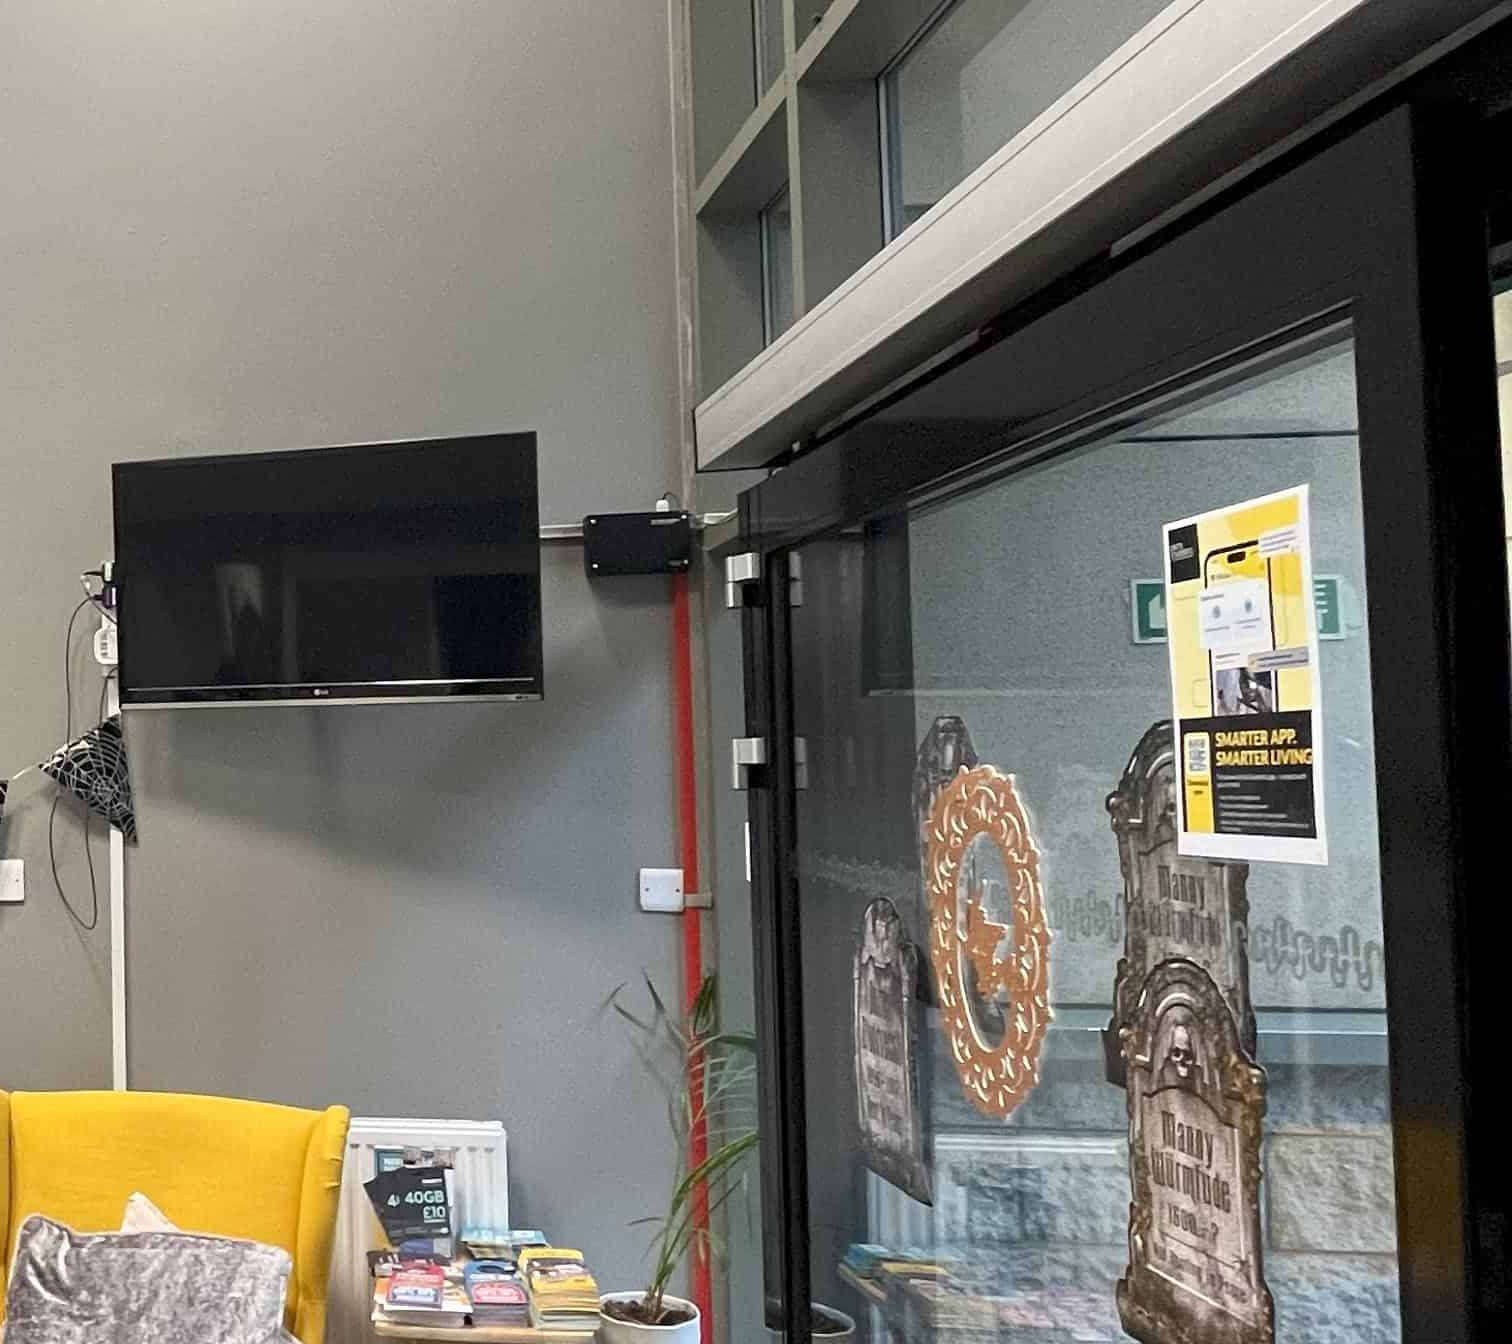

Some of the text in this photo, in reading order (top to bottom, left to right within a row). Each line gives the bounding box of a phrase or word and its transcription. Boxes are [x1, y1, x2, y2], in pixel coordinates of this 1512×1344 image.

[1215, 728, 1299, 747] SMARTER APP.
[1215, 750, 1269, 767] SMARTER
[404, 1189, 445, 1204] 40GB
[423, 1205, 446, 1219] £10
